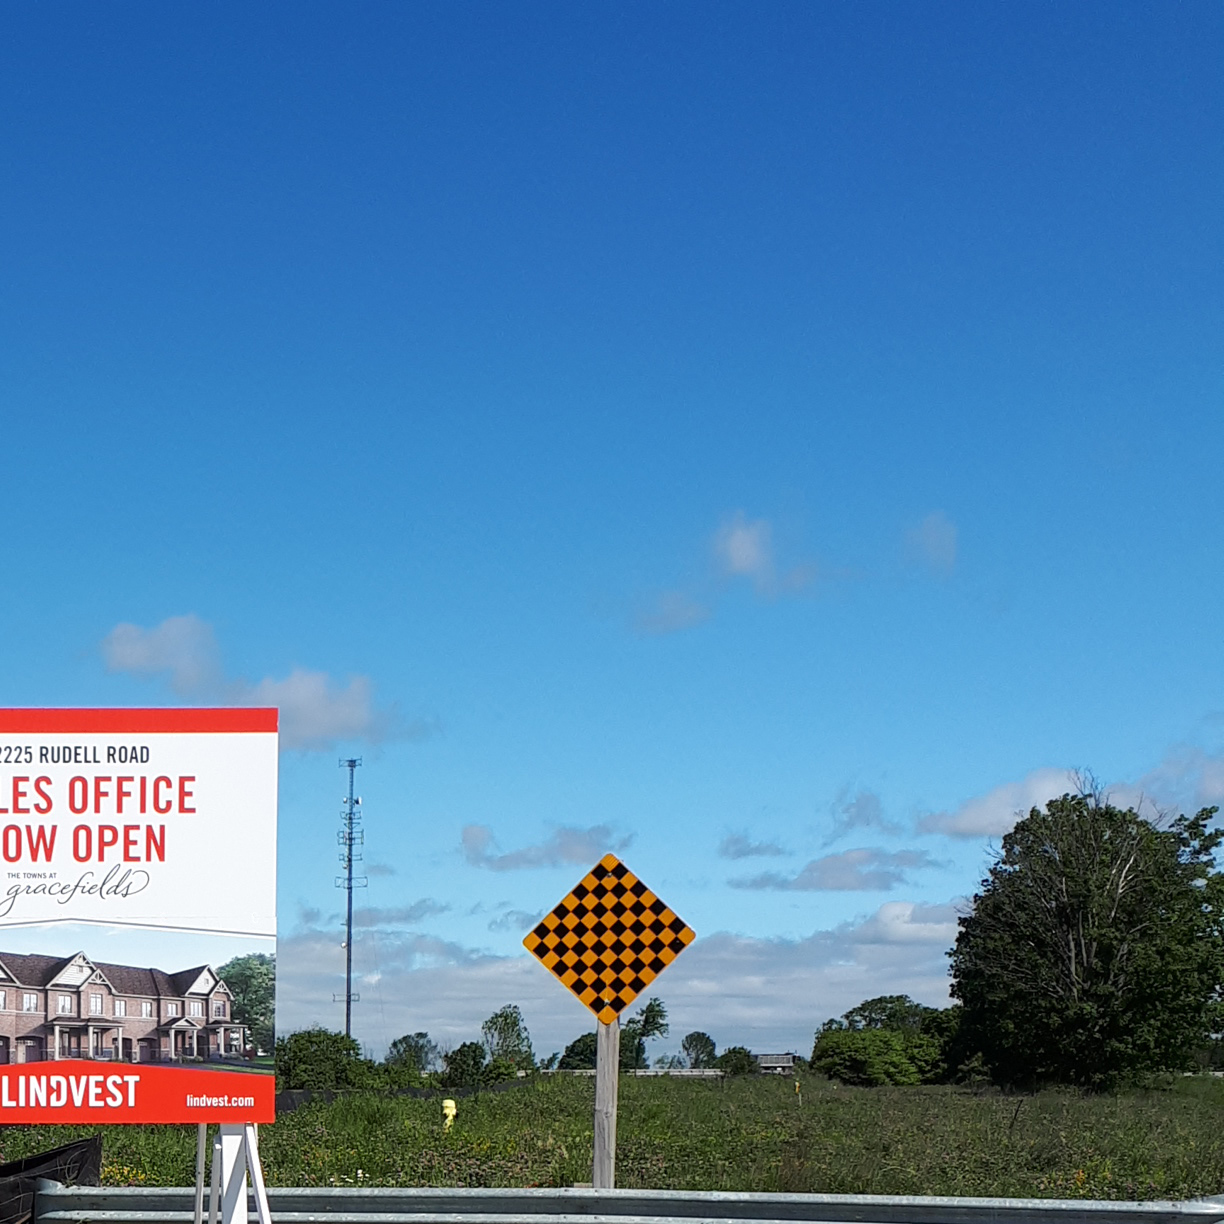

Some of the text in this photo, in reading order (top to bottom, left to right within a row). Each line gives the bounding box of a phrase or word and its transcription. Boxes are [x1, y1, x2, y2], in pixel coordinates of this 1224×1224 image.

[39, 745, 100, 763] RUDELL
[107, 745, 150, 763] ROAD
[69, 776, 196, 814] OFFICE
[73, 824, 165, 862] OPEN
[1, 1075, 140, 1107] LINDVEST
[186, 1094, 254, 1107] lindvest.com
